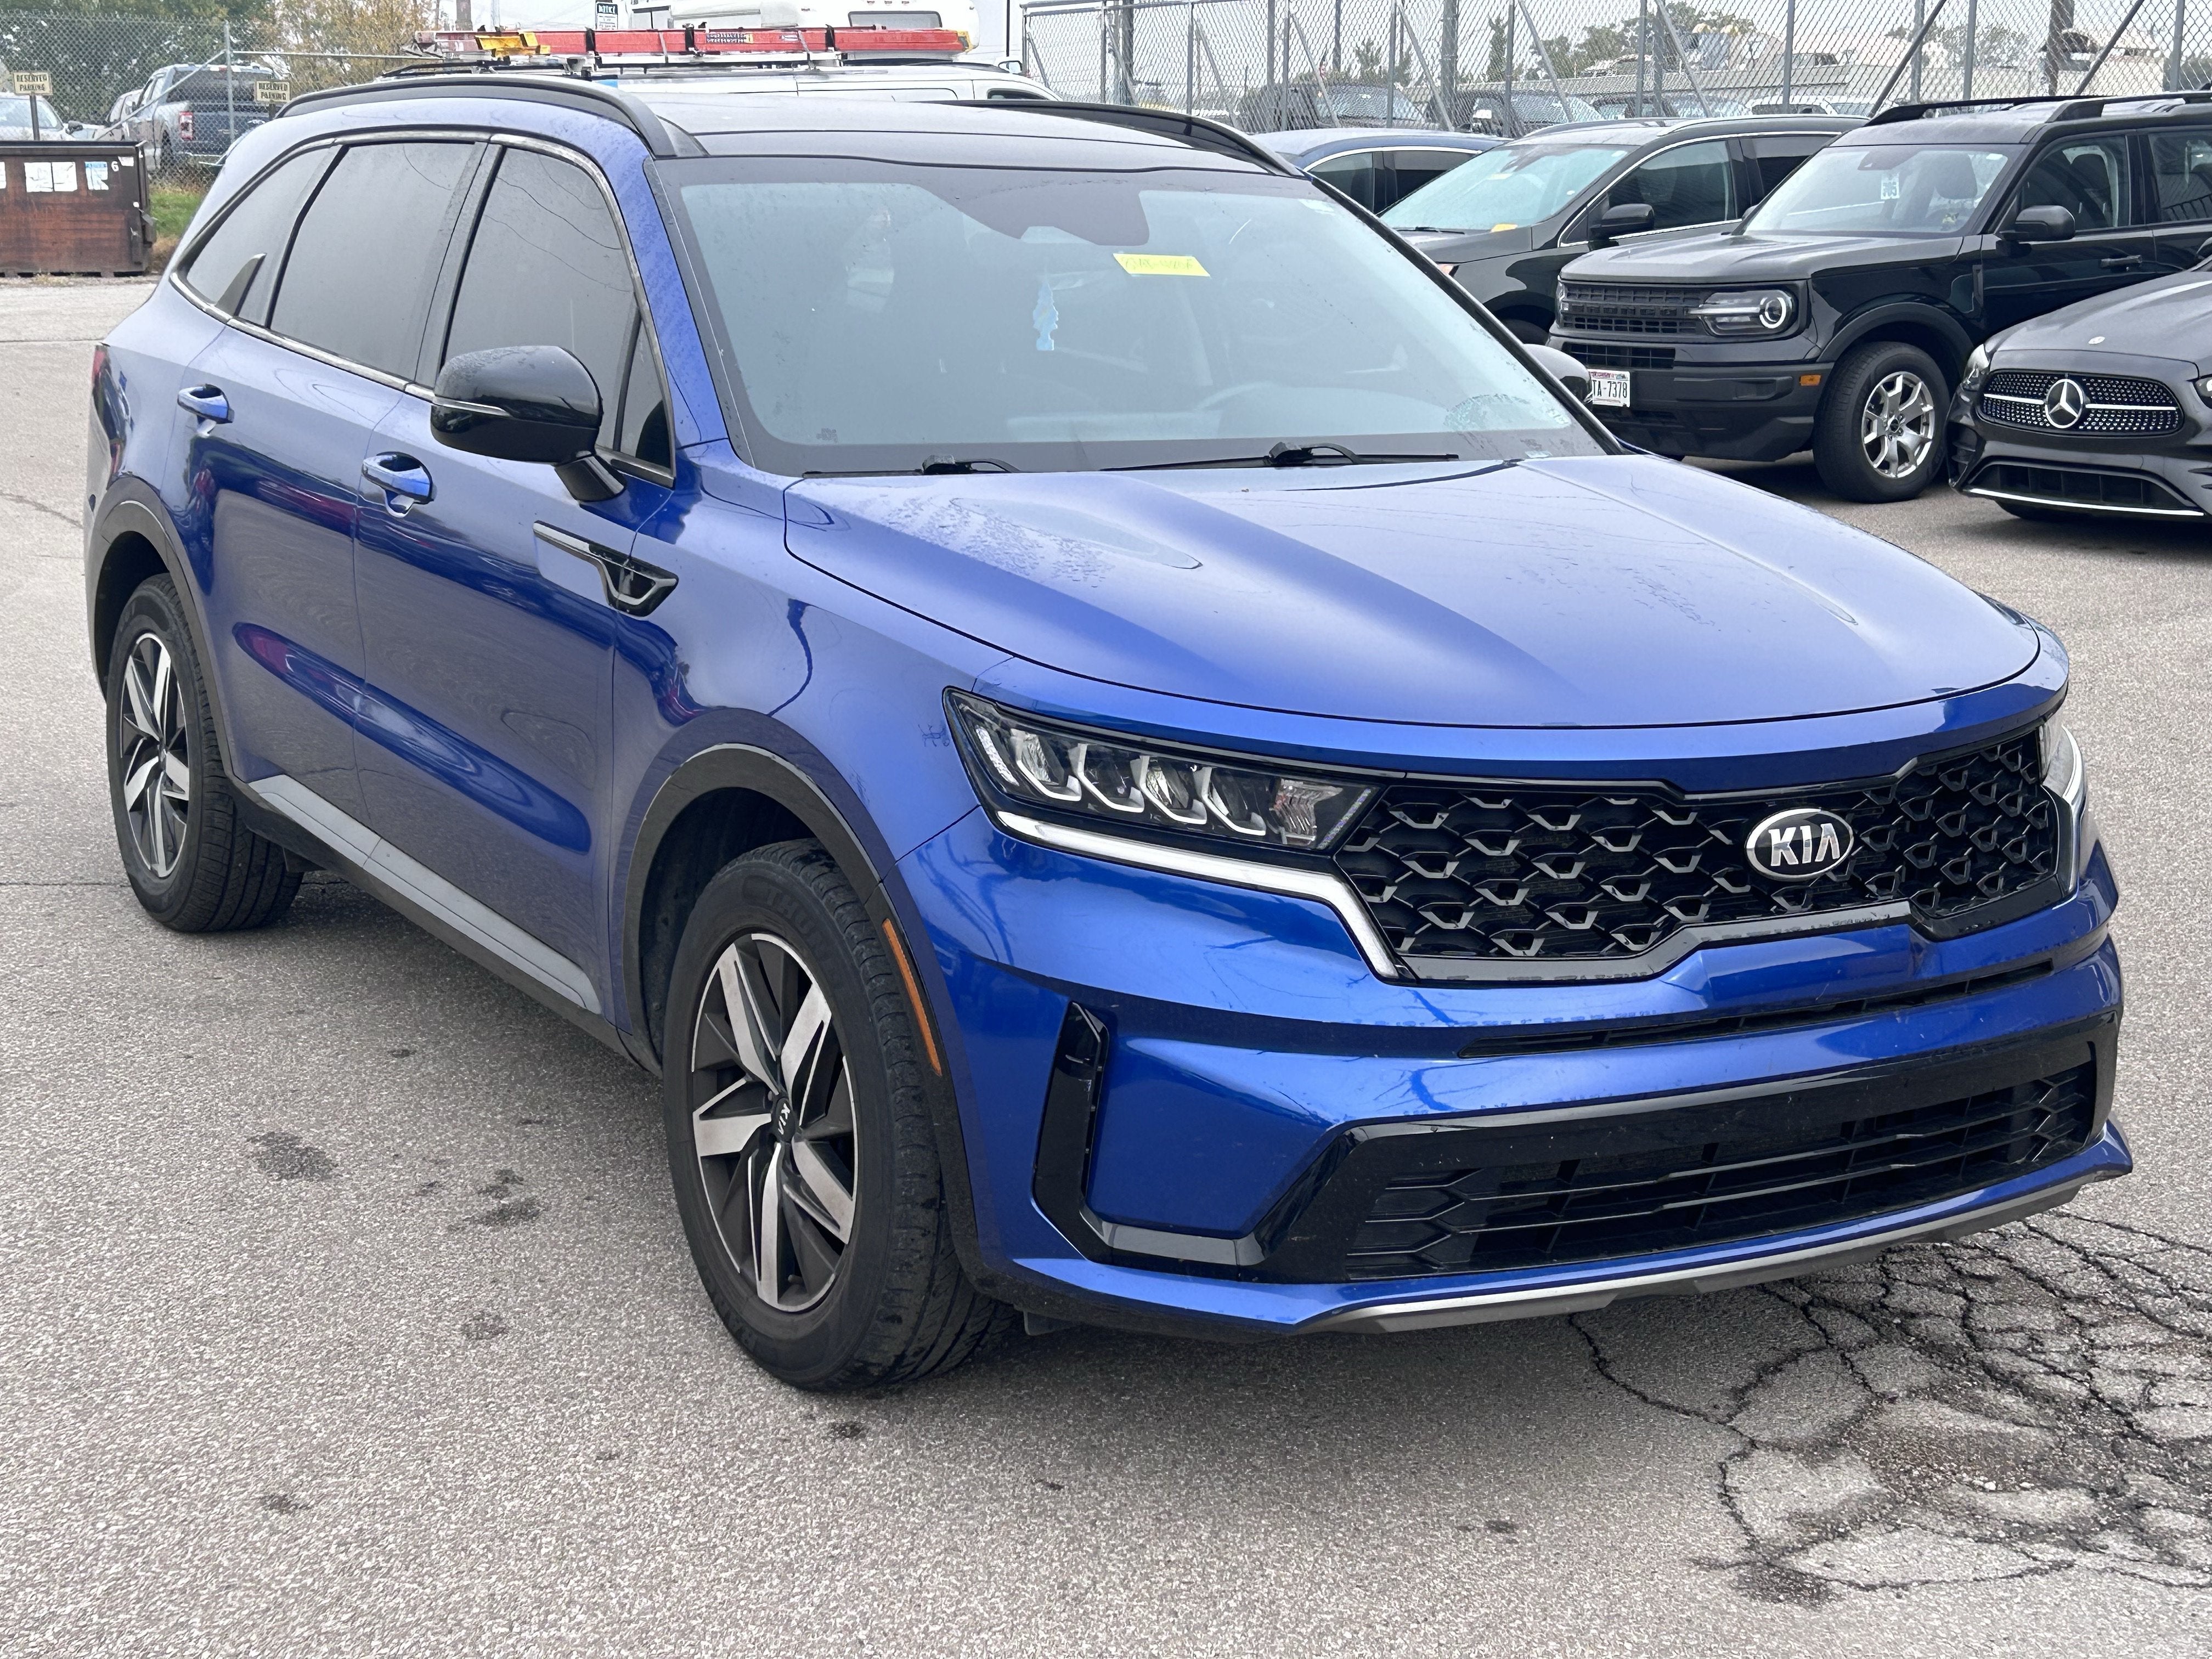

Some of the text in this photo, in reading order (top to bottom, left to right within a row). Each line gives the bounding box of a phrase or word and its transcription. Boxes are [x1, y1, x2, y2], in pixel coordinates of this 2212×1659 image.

[1592, 380, 1627, 398] TA-7378
[1768, 823, 1840, 866] KIA
[777, 1102, 791, 1135] KIA
